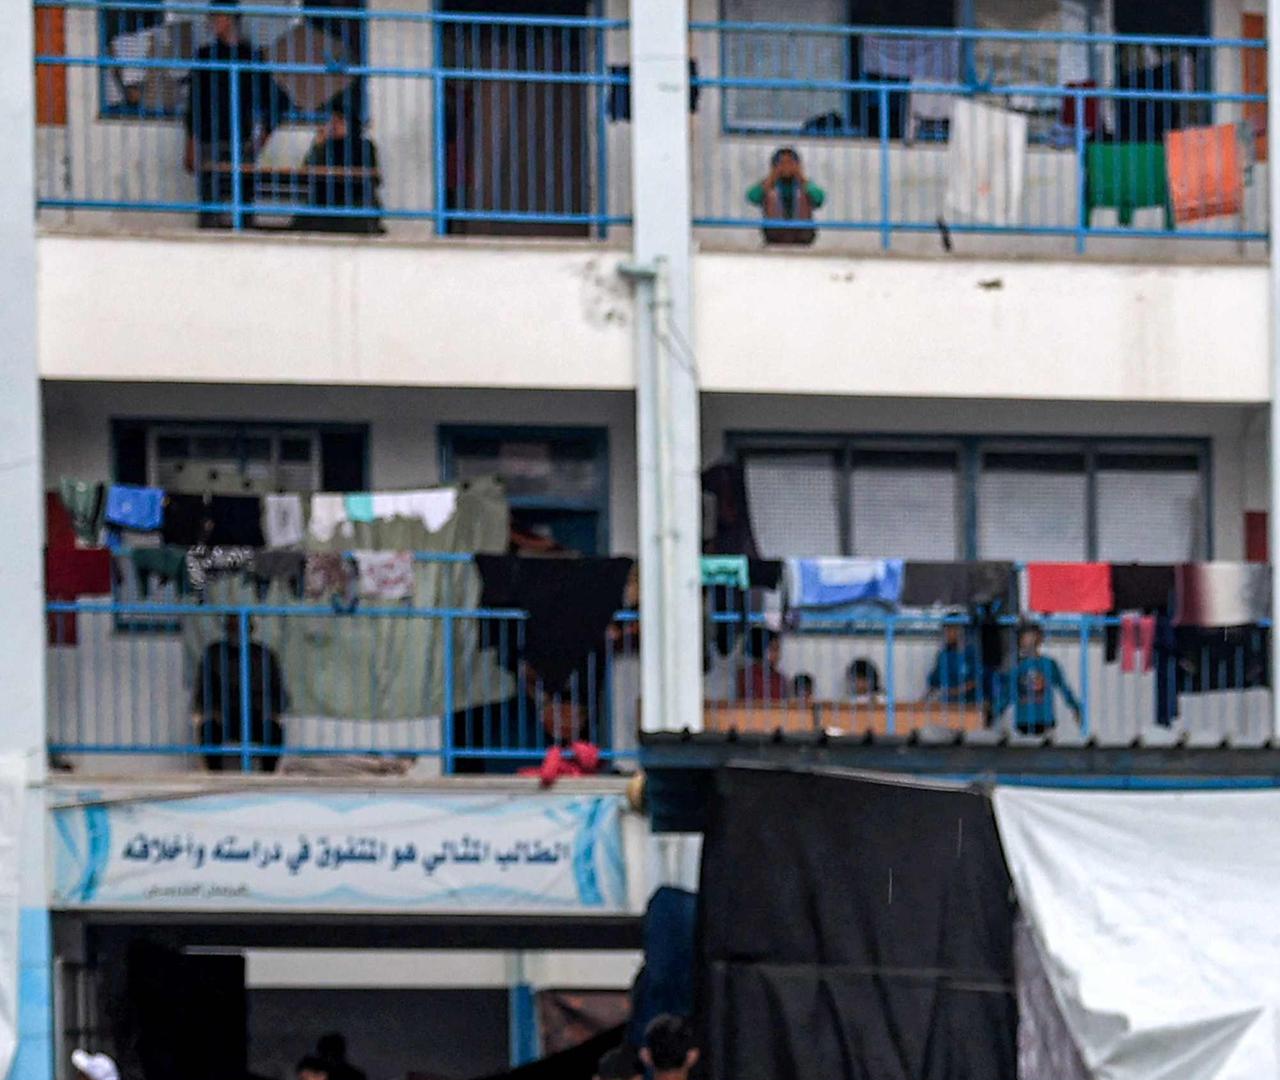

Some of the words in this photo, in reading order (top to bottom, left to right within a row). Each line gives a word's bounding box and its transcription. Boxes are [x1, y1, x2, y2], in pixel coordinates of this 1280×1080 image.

[122, 832, 206, 869] وأخلاقه
[212, 835, 281, 869] دراسته
[287, 833, 310, 876] في
[316, 835, 387, 871] المتفوق
[391, 840, 417, 871] هو
[422, 834, 490, 876] المثالي
[496, 839, 570, 871] الطالب
